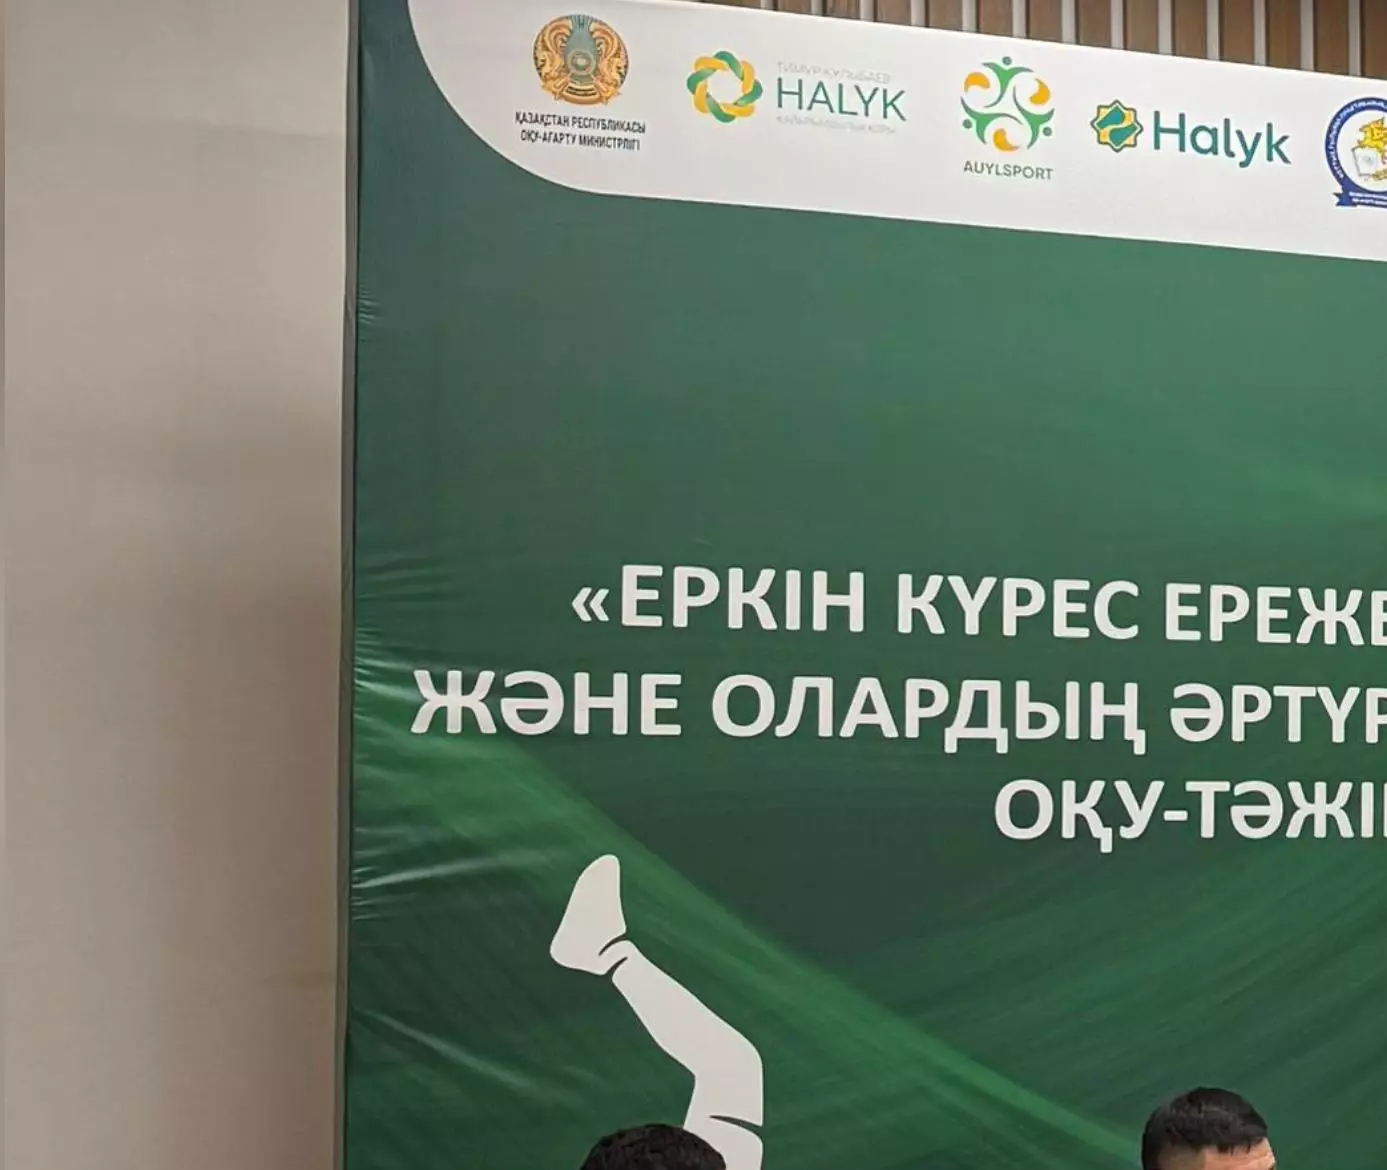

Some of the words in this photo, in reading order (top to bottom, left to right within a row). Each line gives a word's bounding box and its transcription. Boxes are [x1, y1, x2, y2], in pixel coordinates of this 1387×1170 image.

[515, 112, 570, 129] ҚАЗАҚСТАН
[572, 116, 646, 134] РЕСПУБЛИКАСЫ
[777, 77, 907, 122] HALYK
[1153, 110, 1291, 168] Halyk
[963, 160, 1054, 180] AUYLSPORT
[570, 563, 865, 634] «ЕРКІН
[897, 573, 1140, 640] КҮРЕС
[410, 669, 683, 737] ЖӘНЕ
[711, 674, 1147, 756] ОЛАРДЫҢ
